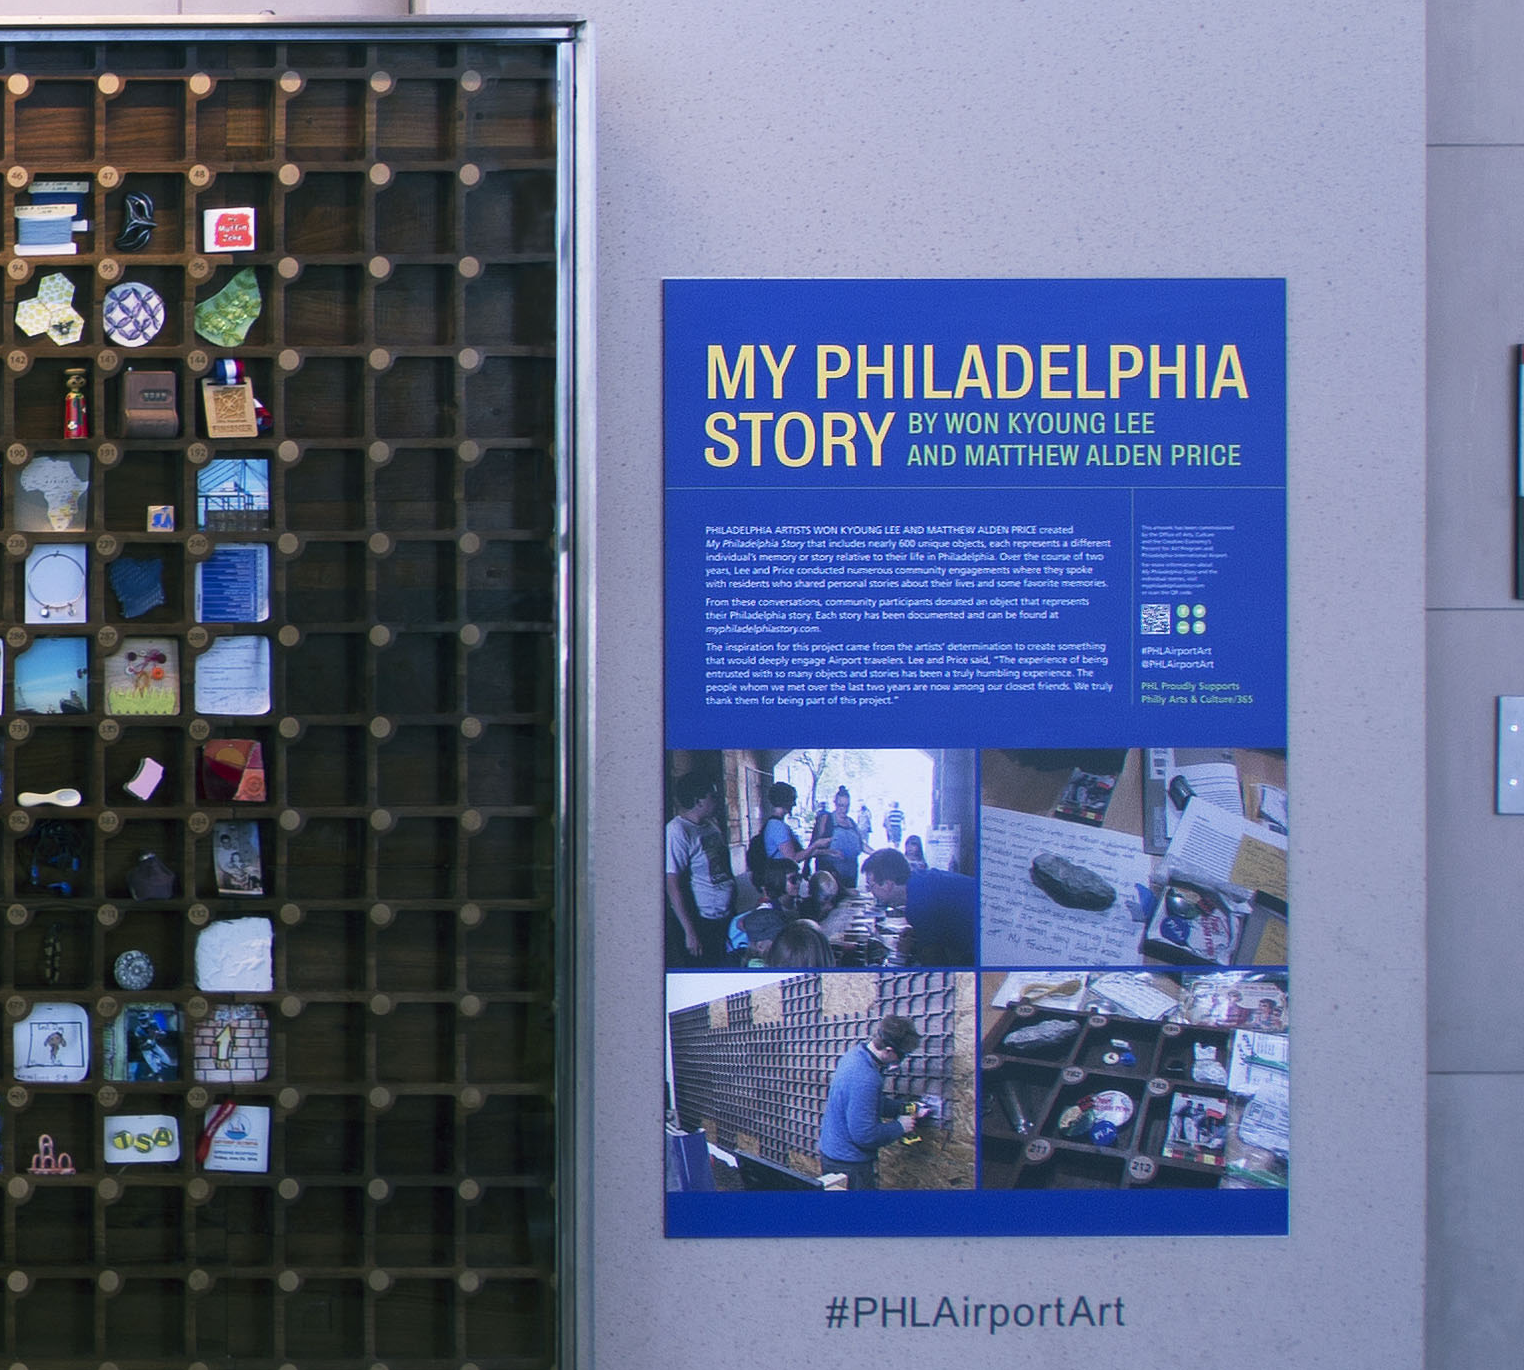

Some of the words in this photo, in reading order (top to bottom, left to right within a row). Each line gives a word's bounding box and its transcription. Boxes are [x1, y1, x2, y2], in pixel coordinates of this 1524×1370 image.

[193, 169, 206, 179] 48
[708, 344, 796, 400] MY
[817, 343, 1249, 400] PHILADELPHIA
[909, 412, 938, 434] BY
[945, 411, 999, 435] WON
[1008, 411, 1106, 434] KYOUNG
[1115, 412, 1155, 434] LEE
[704, 411, 896, 468] STORY
[906, 444, 957, 467] AND
[965, 444, 1081, 467] MATTHEW
[1085, 444, 1163, 466] ALDEN
[1171, 444, 1242, 466] PRICE
[705, 525, 773, 535] PHILADELPHIA
[774, 525, 812, 535] ARTISTS
[812, 525, 838, 535] WON
[840, 525, 883, 535] KYOUNG
[884, 525, 901, 535] LEE
[902, 525, 925, 535] AND
[926, 525, 977, 535] MATTHEW
[977, 525, 1010, 535] ALDEN
[1011, 525, 1037, 535] PRICE
[1038, 525, 1075, 535] created
[706, 539, 721, 550] My
[722, 538, 780, 550] Philadelphia
[781, 538, 806, 550] Story
[807, 539, 826, 548] that
[828, 539, 866, 548] includes
[868, 539, 897, 550] nearly
[898, 538, 916, 548] 600
[917, 539, 951, 550] unique
[952, 539, 987, 550] objects,
[989, 539, 1011, 548] each
[1012, 539, 1061, 550] represents
[1070, 537, 1112, 547] different
[705, 597, 730, 607] From
[731, 597, 757, 607] these
[758, 597, 823, 609] conversations,
[825, 597, 878, 609] community
[878, 596, 934, 609] participants
[934, 597, 975, 606] donated
[989, 596, 1019, 608] object
[1020, 597, 1040, 606] that
[1042, 598, 1090, 608] represents
[705, 611, 727, 620] their
[729, 610, 787, 622] Philadelphia
[788, 611, 814, 622] story.
[815, 610, 838, 620] Each
[838, 611, 863, 622] story
[864, 610, 881, 620] has
[882, 610, 906, 620] been
[907, 610, 965, 620] documented
[966, 610, 985, 620] and
[987, 612, 1004, 620] can
[1005, 610, 1018, 620] be
[1019, 609, 1048, 620] found
[1049, 611, 1060, 620] at
[705, 623, 822, 636] myphiladelphiastory.com.
[1141, 645, 1213, 657] #PHLAirportArt
[1141, 659, 1215, 670] @PHLAirportArt
[1141, 681, 1159, 691] PHL
[1161, 681, 1197, 693] Proudly
[1198, 681, 1240, 693] Supports
[1140, 694, 1167, 706] Philly
[1168, 695, 1189, 704] Arts
[1189, 694, 1198, 704] &
[1199, 694, 1254, 704] Culture/365
[825, 1295, 1127, 1336] #PHLAirportArt
